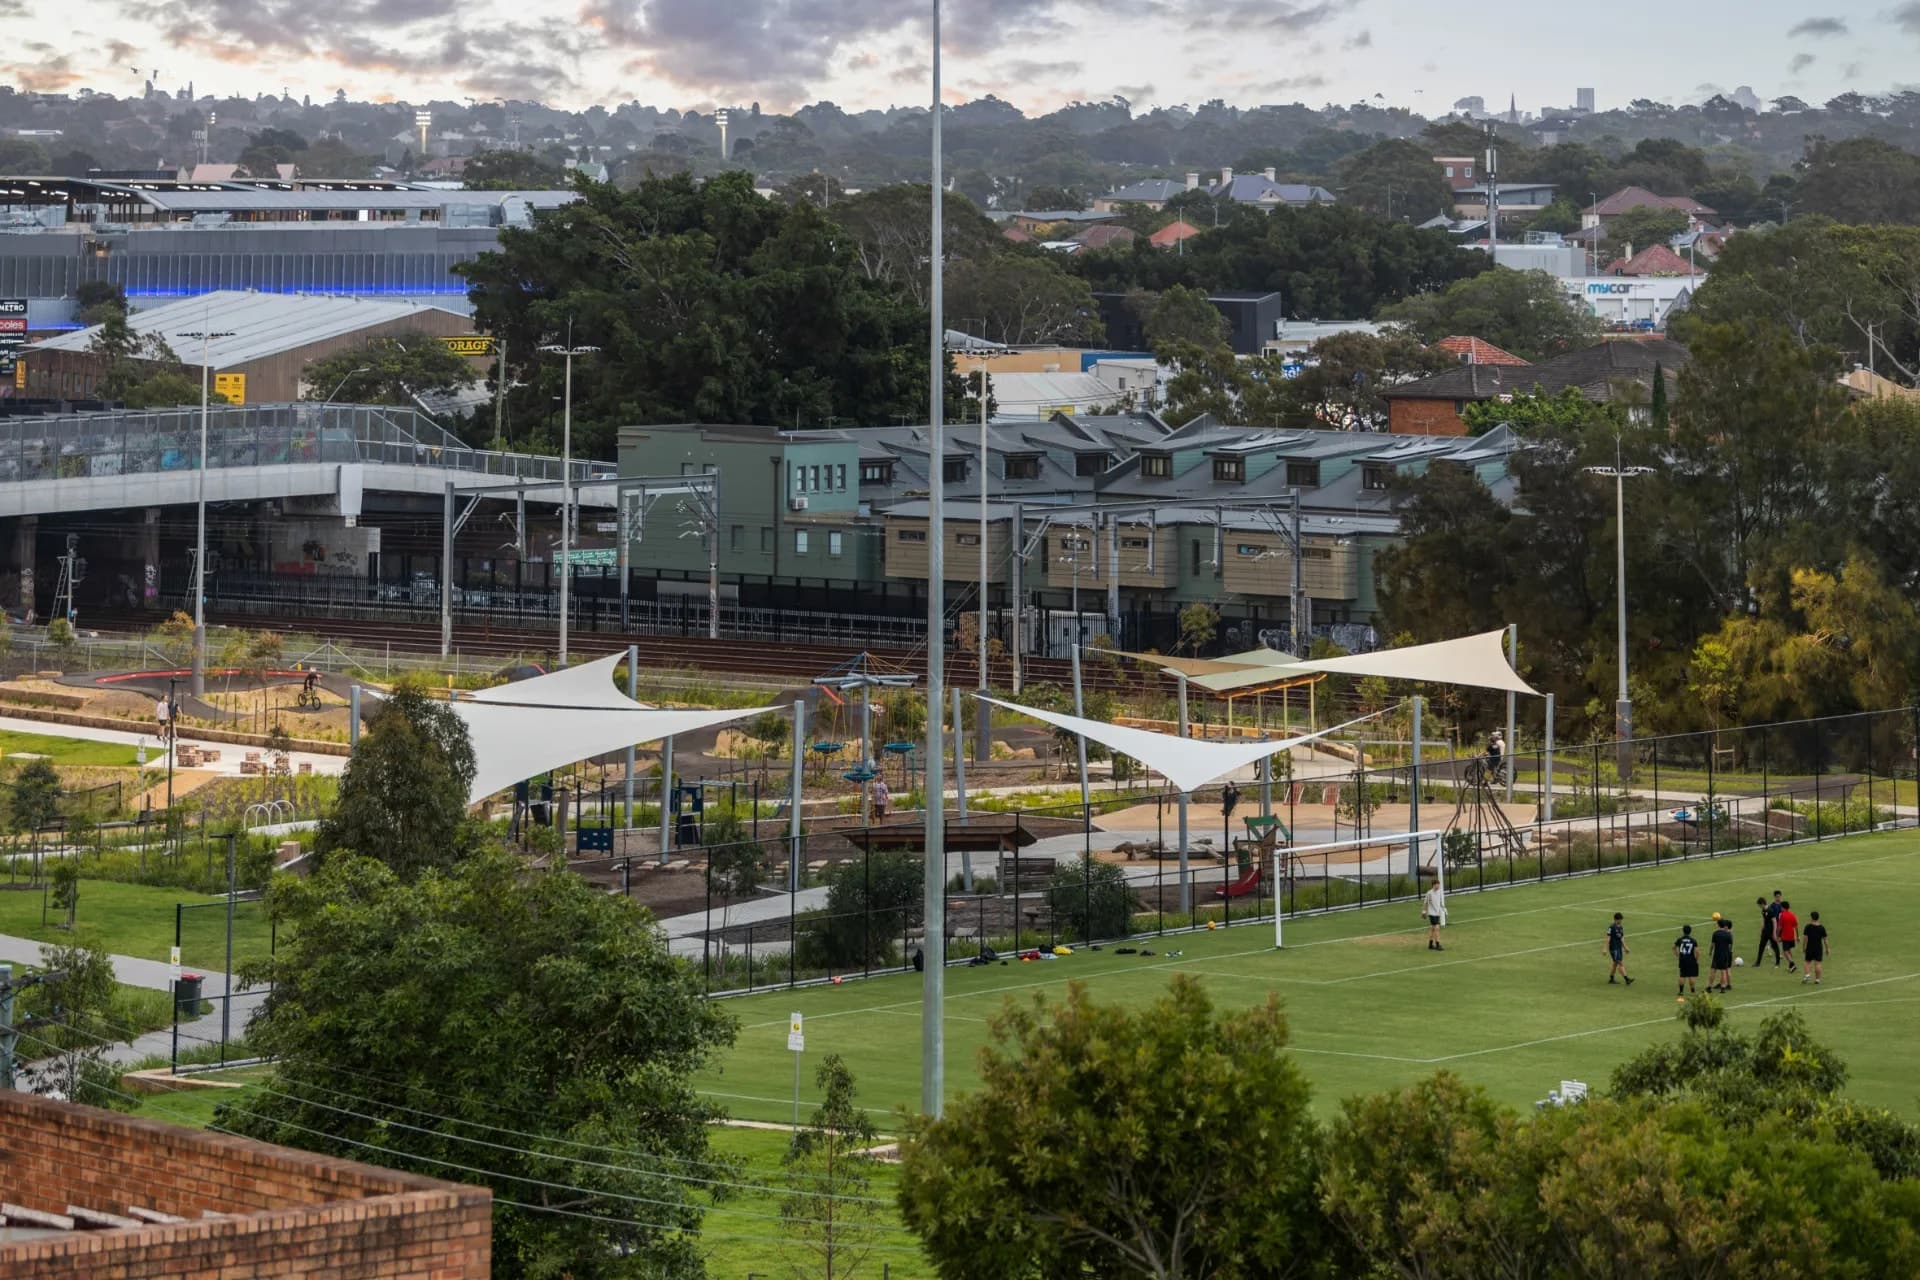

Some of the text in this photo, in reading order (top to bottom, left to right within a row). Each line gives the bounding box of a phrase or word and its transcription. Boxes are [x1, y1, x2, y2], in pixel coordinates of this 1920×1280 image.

[1588, 283, 1632, 294] mycar
[0, 320, 24, 329] coles
[447, 340, 489, 351] ORAGE
[1679, 943, 1693, 955] 47
